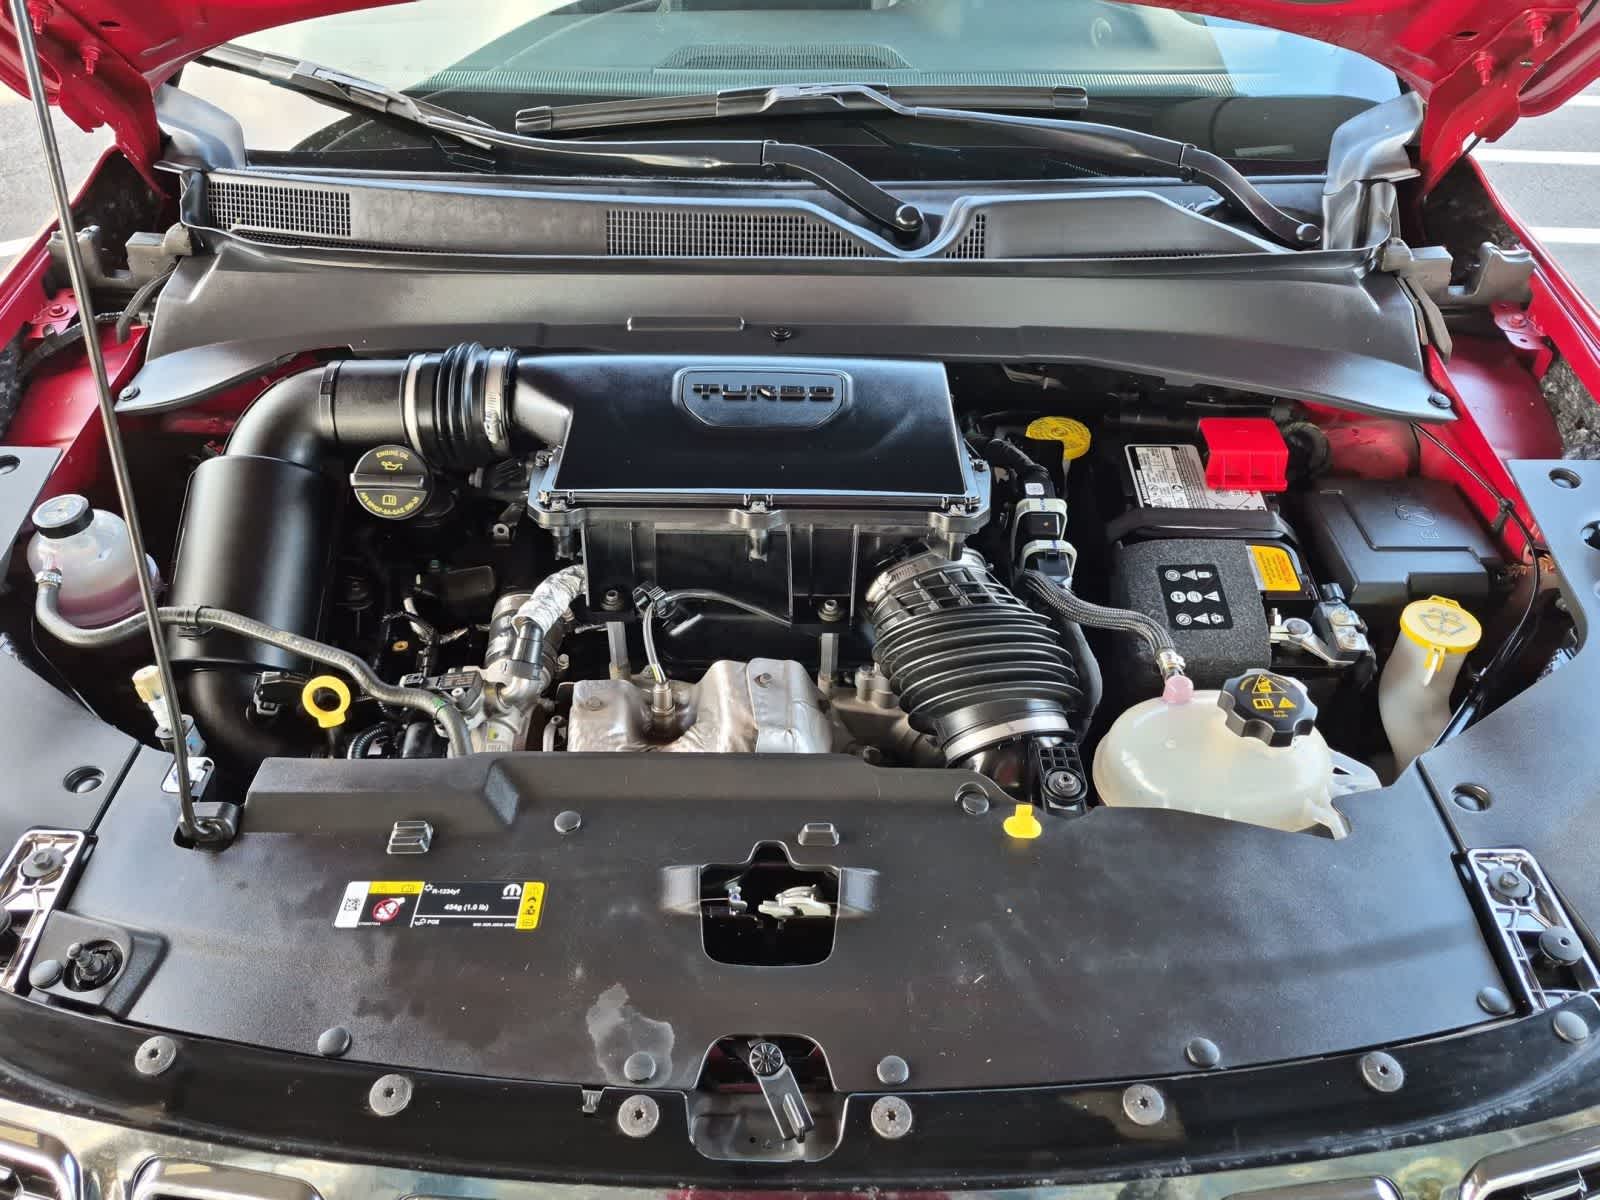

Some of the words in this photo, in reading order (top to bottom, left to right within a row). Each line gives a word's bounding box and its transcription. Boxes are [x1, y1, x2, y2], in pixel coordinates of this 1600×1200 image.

[692, 384, 834, 402] TURBO
[376, 449, 399, 459] ENGINE
[399, 450, 409, 460] OIL
[443, 904, 463, 912] 454g
[463, 904, 478, 912] (1.0
[478, 904, 489, 912] lb)
